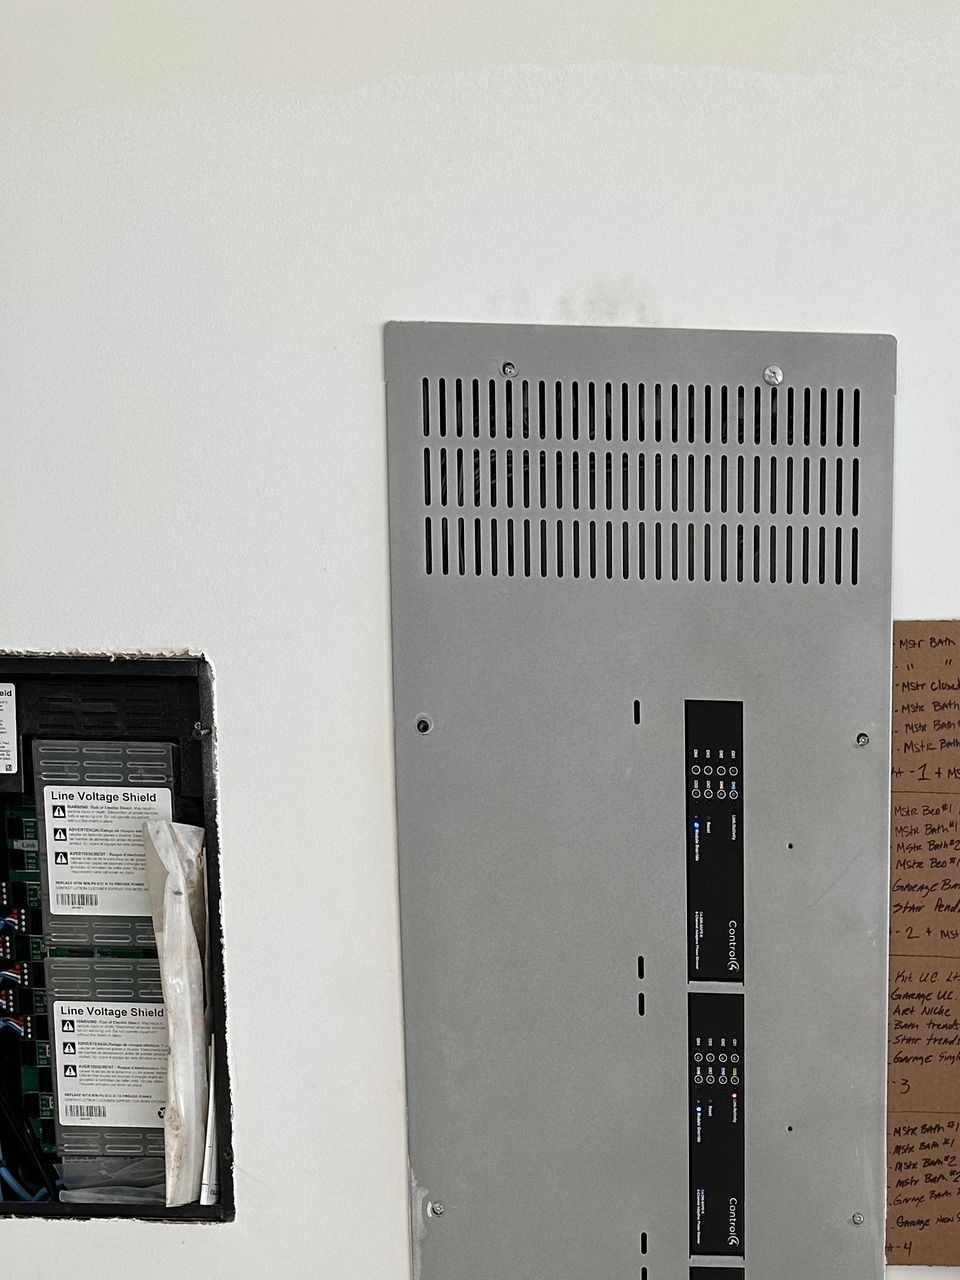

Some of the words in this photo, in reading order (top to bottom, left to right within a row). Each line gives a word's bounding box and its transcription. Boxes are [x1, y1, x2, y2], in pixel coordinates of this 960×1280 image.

[52, 791, 74, 800] Line
[78, 792, 119, 803] Voltage
[122, 793, 156, 802] Shield
[727, 920, 739, 973] Control4
[61, 1006, 83, 1015] Line
[87, 1007, 127, 1018] Voltage
[131, 1008, 164, 1017] Shield
[727, 1198, 739, 1246] Control4
